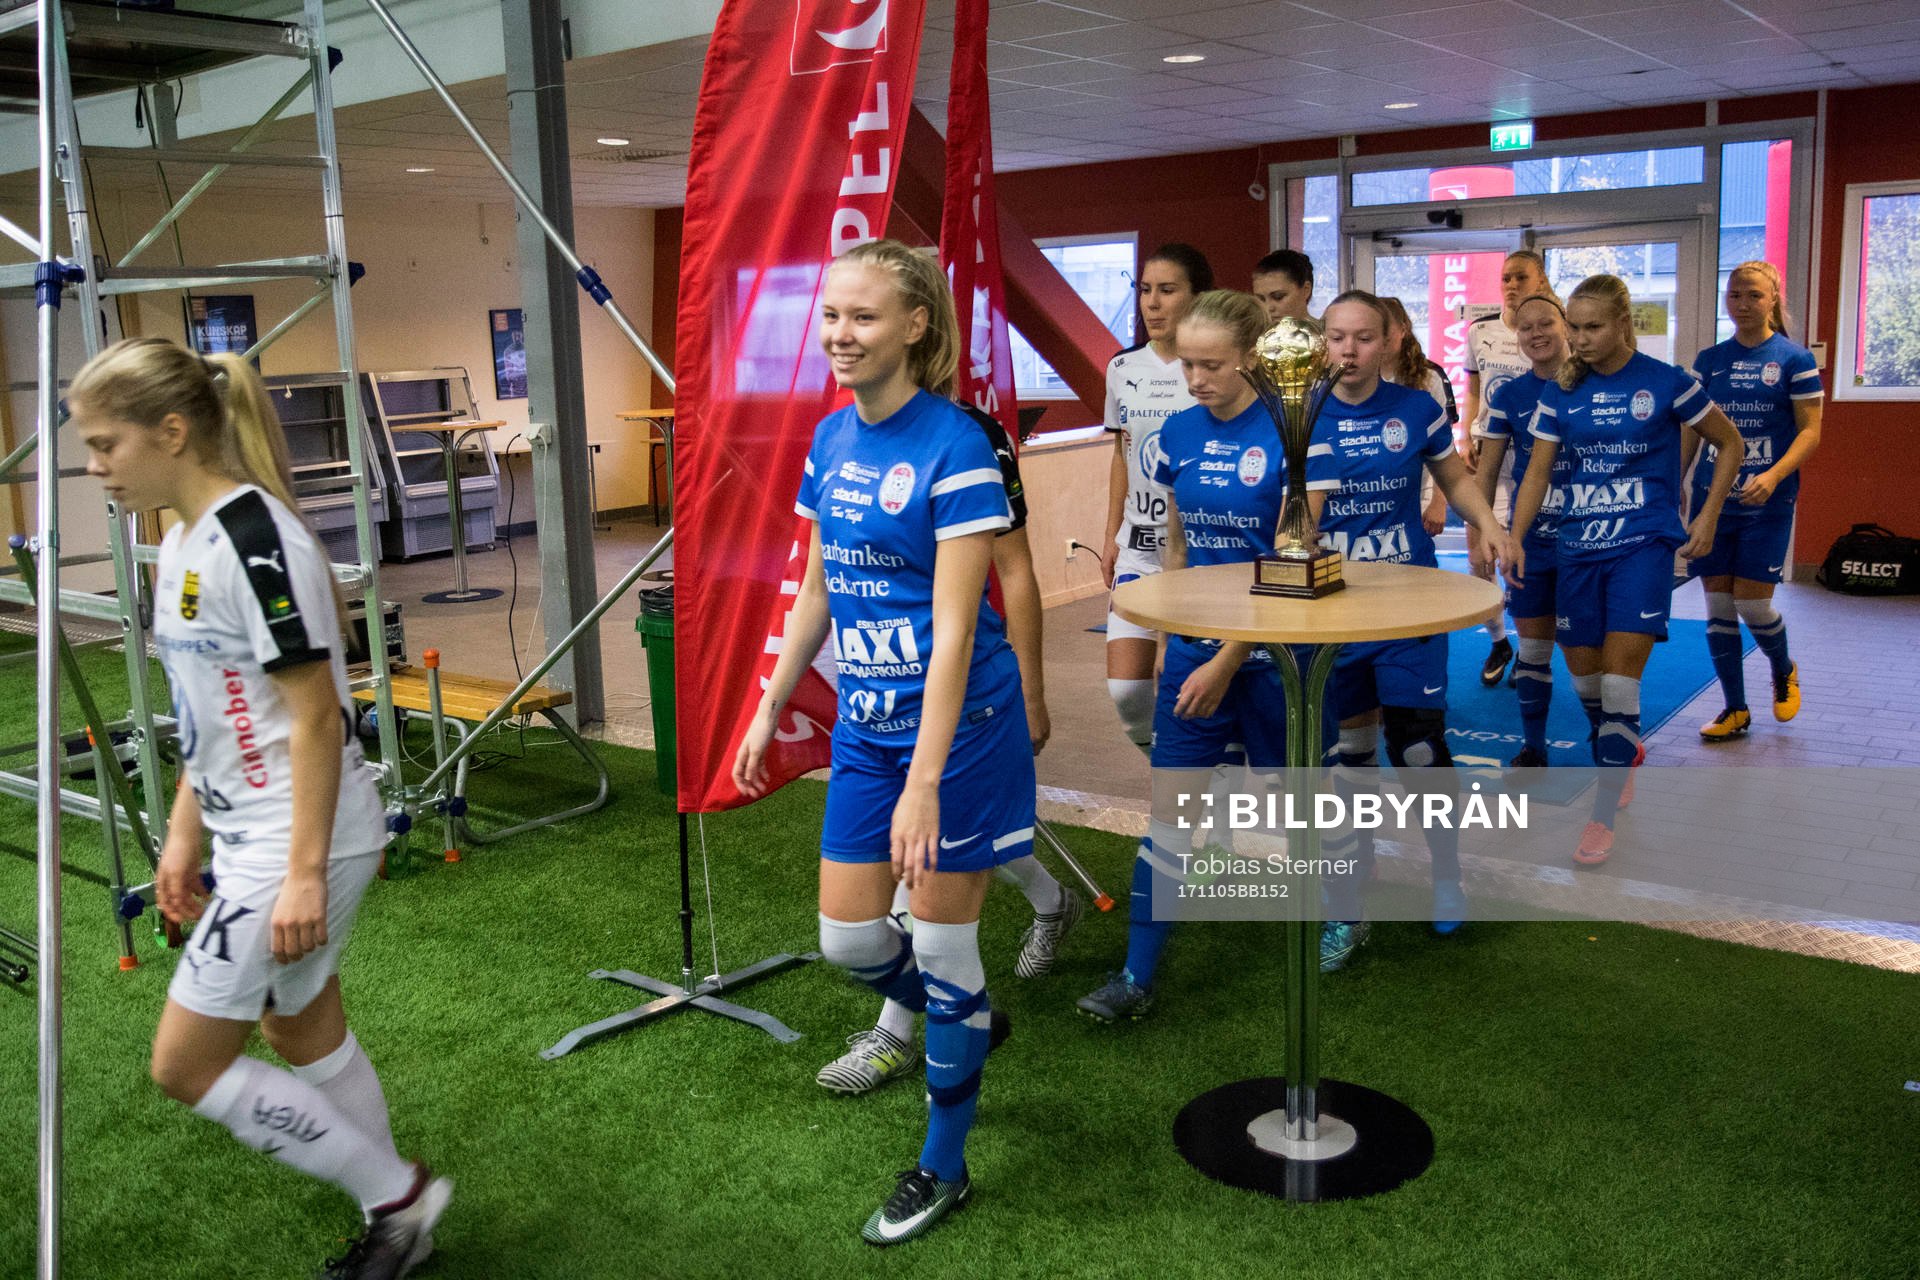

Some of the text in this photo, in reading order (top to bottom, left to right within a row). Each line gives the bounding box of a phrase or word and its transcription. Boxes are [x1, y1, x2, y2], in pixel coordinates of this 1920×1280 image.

[197, 325, 248, 337] KUNSKAP
[1591, 406, 1628, 416] stadium
[1338, 435, 1382, 447] stadium
[1198, 460, 1237, 472] stadium
[831, 487, 874, 507] stadium
[1329, 500, 1395, 517] Rekarne
[1179, 507, 1260, 529] parbanken
[1184, 529, 1251, 549] Rekarne
[1318, 528, 1411, 561] MAXI
[1841, 560, 1902, 578] SELECT
[1444, 727, 1577, 749] BSÖN
